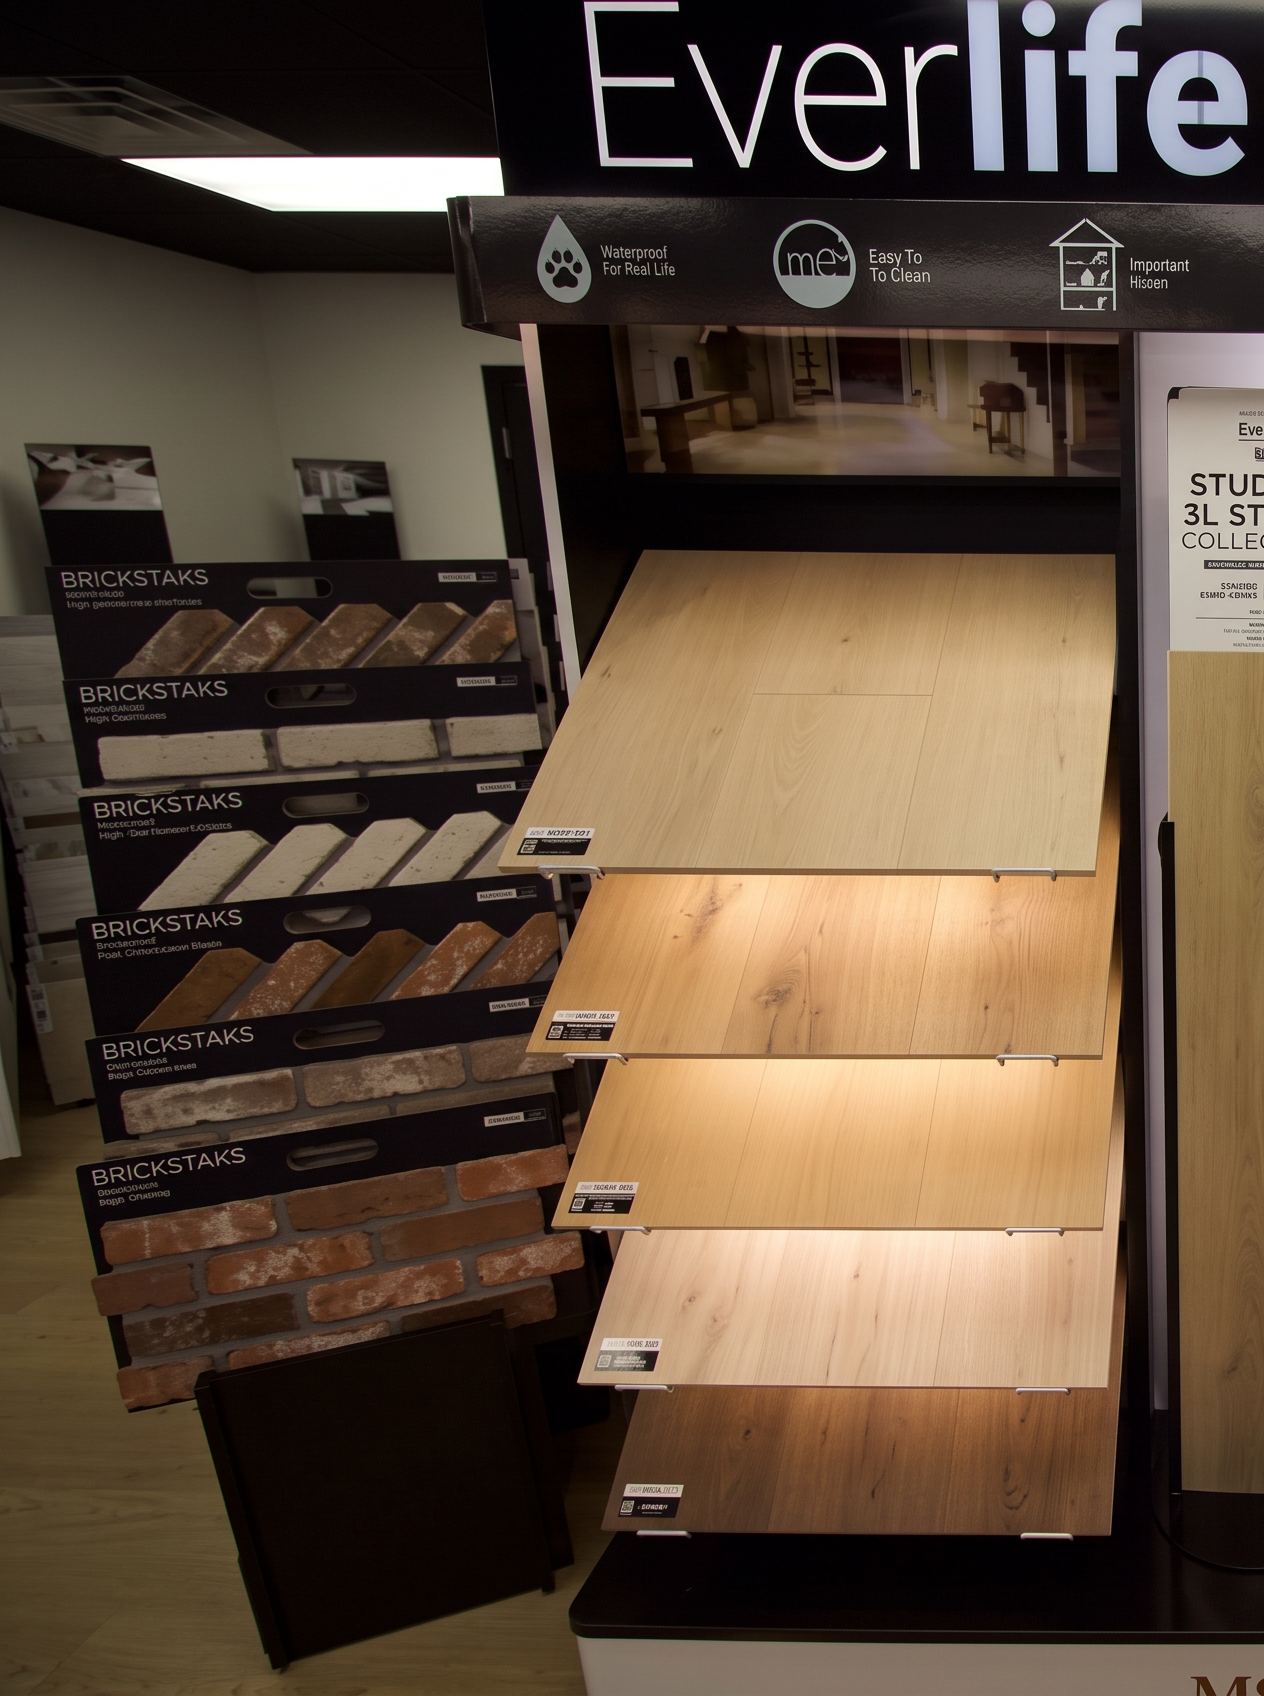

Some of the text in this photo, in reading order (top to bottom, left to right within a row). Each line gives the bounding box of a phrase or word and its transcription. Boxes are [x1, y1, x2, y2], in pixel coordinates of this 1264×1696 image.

[583, 0, 1248, 177] Everlife
[600, 244, 668, 262] Waterproof
[869, 249, 923, 267] Easy To
[602, 262, 676, 276] For Real Life
[869, 267, 931, 283] To Clean
[1130, 257, 1190, 275] Important
[1183, 503, 1219, 526] 3L
[60, 569, 209, 588] BRICKSTAKS
[79, 680, 228, 703] BRICKSTAKS
[93, 792, 243, 819] BRICKSTAKS
[91, 909, 243, 940] BRICKSTAKS
[102, 1026, 254, 1060] BRICKSTAKS
[91, 1147, 246, 1186] BRICKSTAKS
